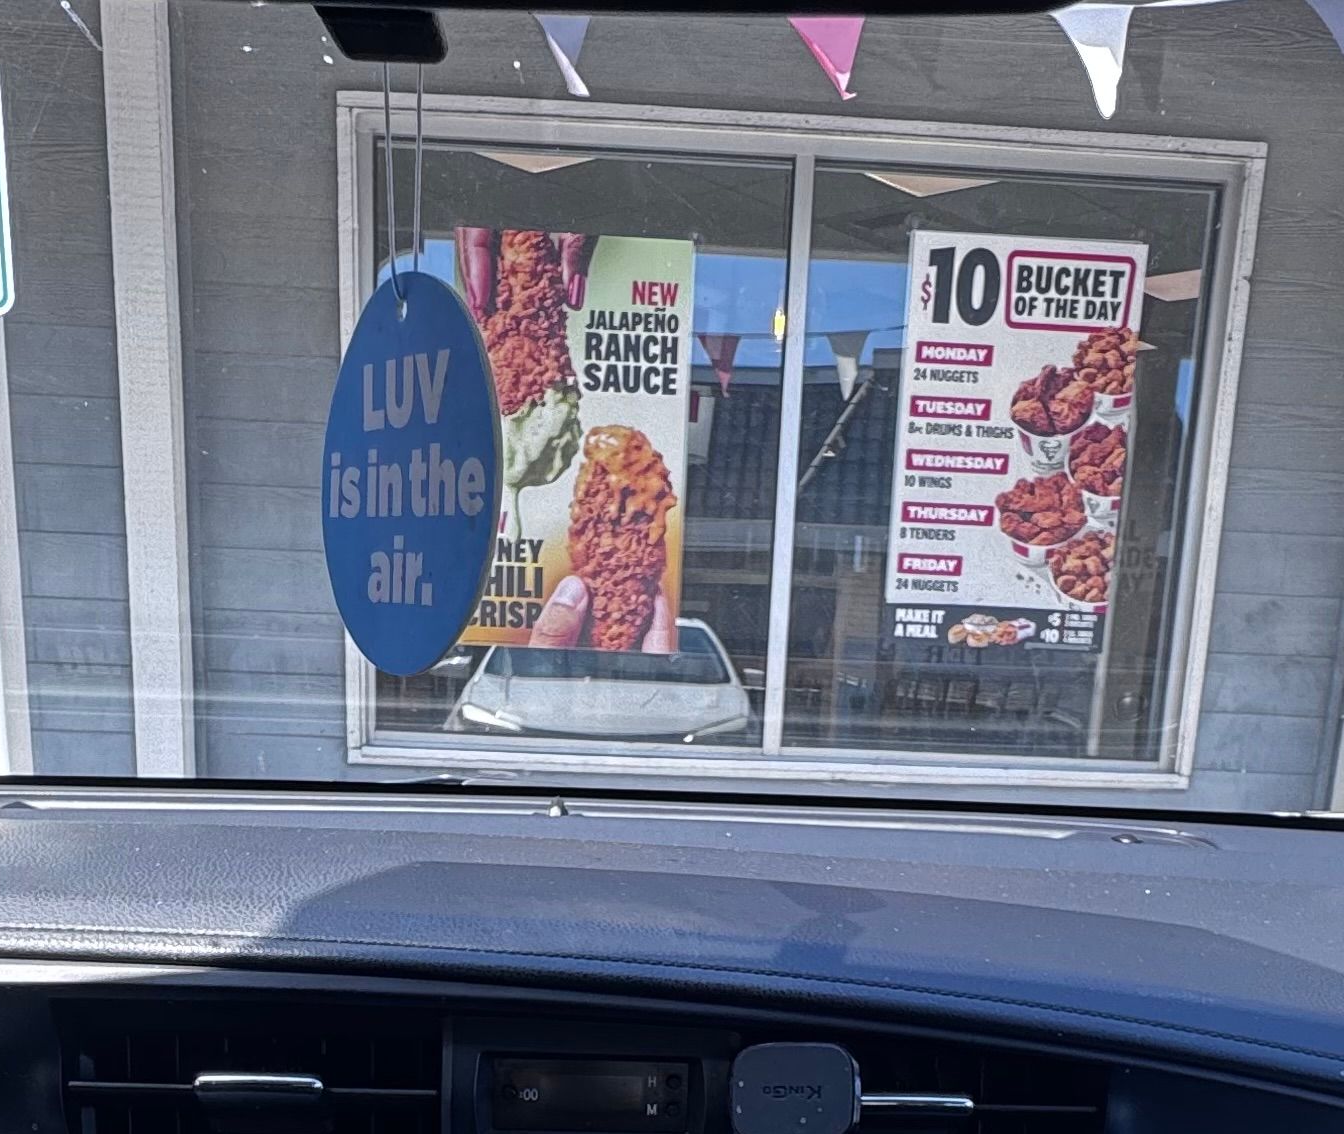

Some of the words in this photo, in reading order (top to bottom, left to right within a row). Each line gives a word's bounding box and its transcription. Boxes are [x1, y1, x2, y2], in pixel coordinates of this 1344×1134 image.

[921, 246, 1001, 326] $10
[1015, 265, 1125, 299] BUCKET
[632, 280, 678, 307] NEW
[1014, 297, 1037, 317] OF
[1044, 298, 1079, 320] THE
[1084, 300, 1122, 322] DAY
[585, 308, 679, 333] JALAPEÑO
[585, 332, 678, 364] RANCH
[921, 345, 988, 362] MONDAY
[583, 363, 678, 395] SAUCE
[913, 368, 927, 381] 24
[930, 369, 979, 384] NUGGETS
[363, 349, 450, 432] LUV
[915, 400, 986, 416] TUESDAY
[925, 422, 962, 437] DRUMS
[975, 425, 1014, 439] THIGHS
[911, 453, 1005, 471] WEDNESDAY
[329, 452, 361, 518] is
[366, 448, 403, 518] in
[408, 443, 486, 518] the
[918, 476, 952, 489] WINGS
[907, 506, 989, 522] THURSDAY
[908, 528, 955, 541] TENDERS
[496, 538, 544, 564] NEY
[367, 535, 433, 606] air.
[903, 558, 958, 572] FRIDAY
[484, 565, 543, 599] HILI
[911, 579, 959, 592] NUGGETS
[647, 1075, 657, 1088] H
[645, 1103, 657, 1116] M
